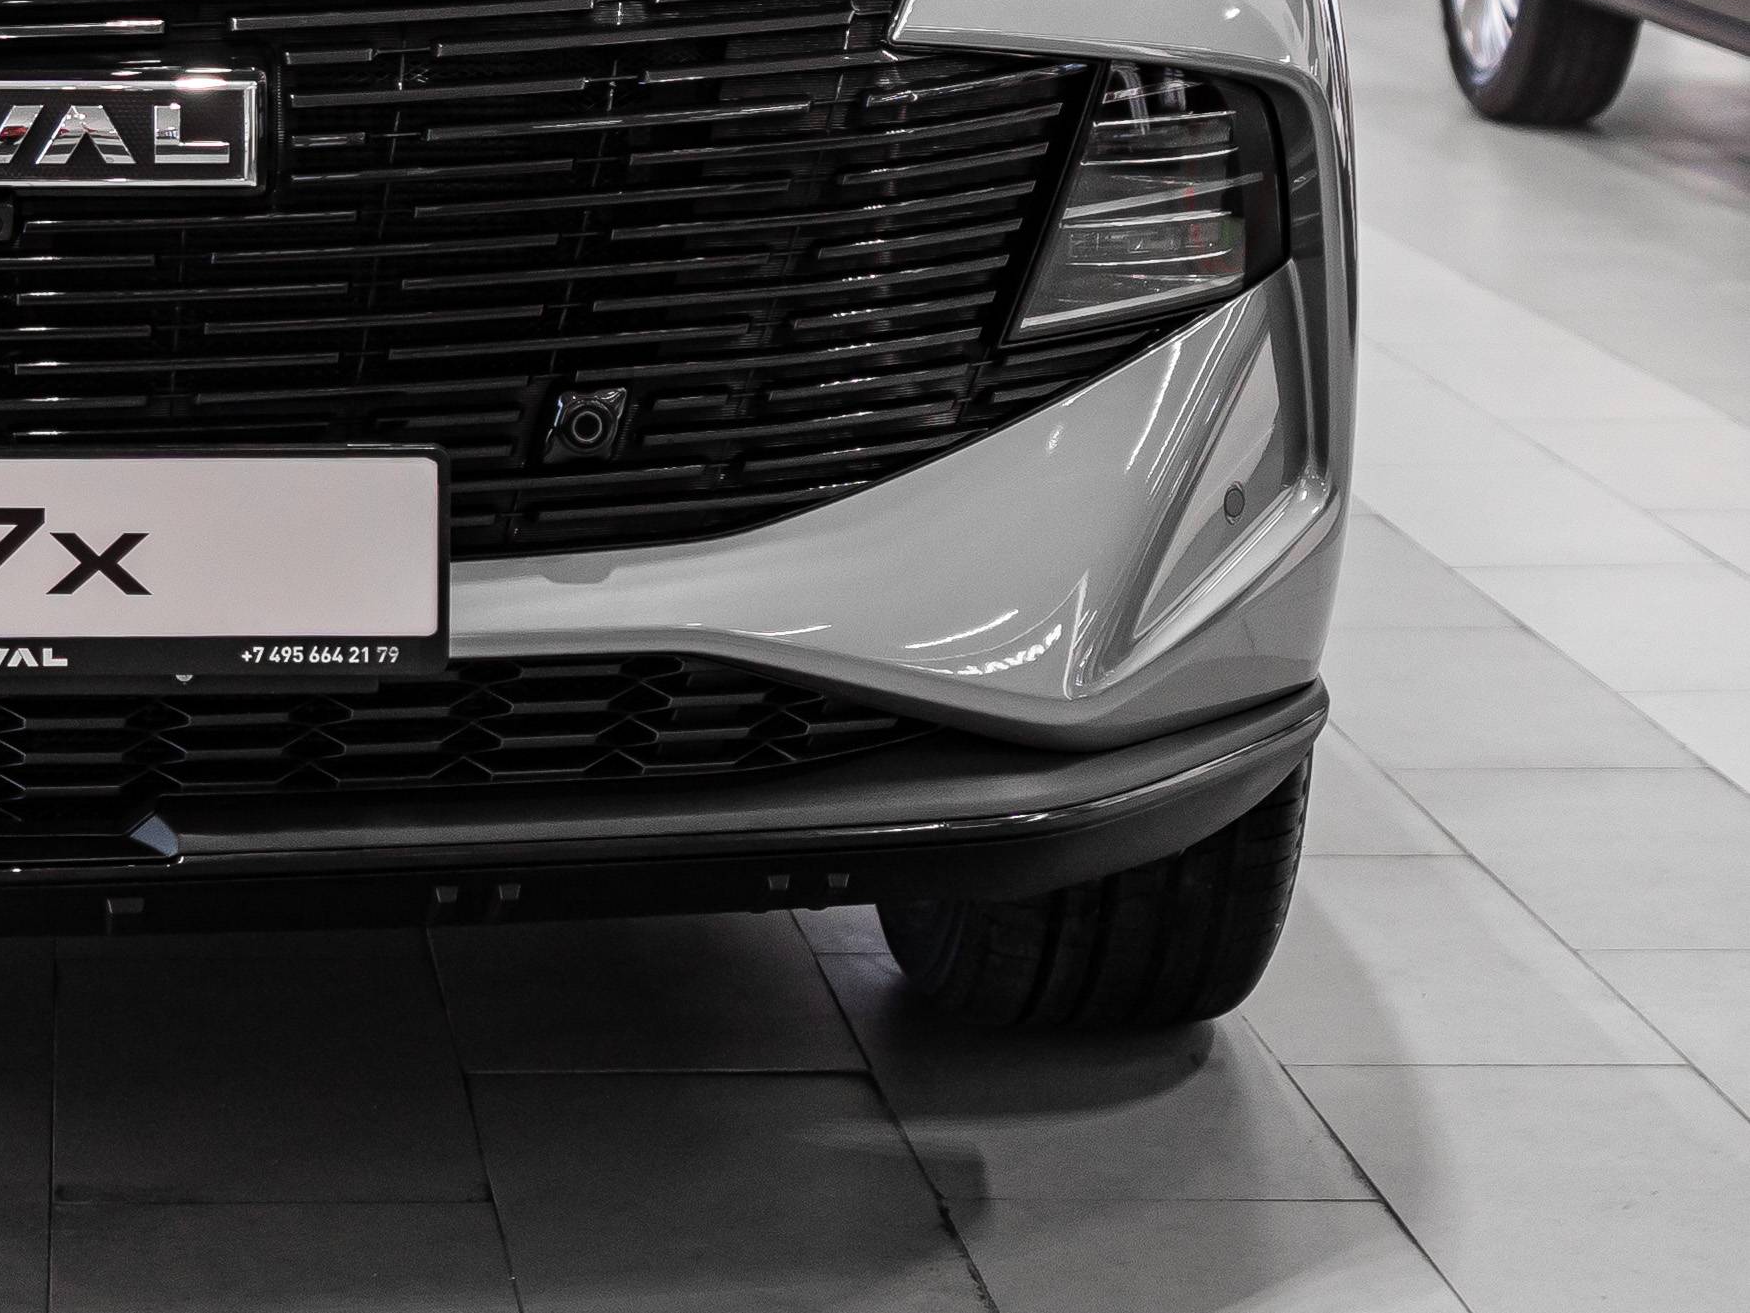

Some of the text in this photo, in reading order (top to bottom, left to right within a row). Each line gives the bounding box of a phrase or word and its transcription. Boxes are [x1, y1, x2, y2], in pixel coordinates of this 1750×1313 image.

[241, 645, 400, 664] +7 495 664 21 79
